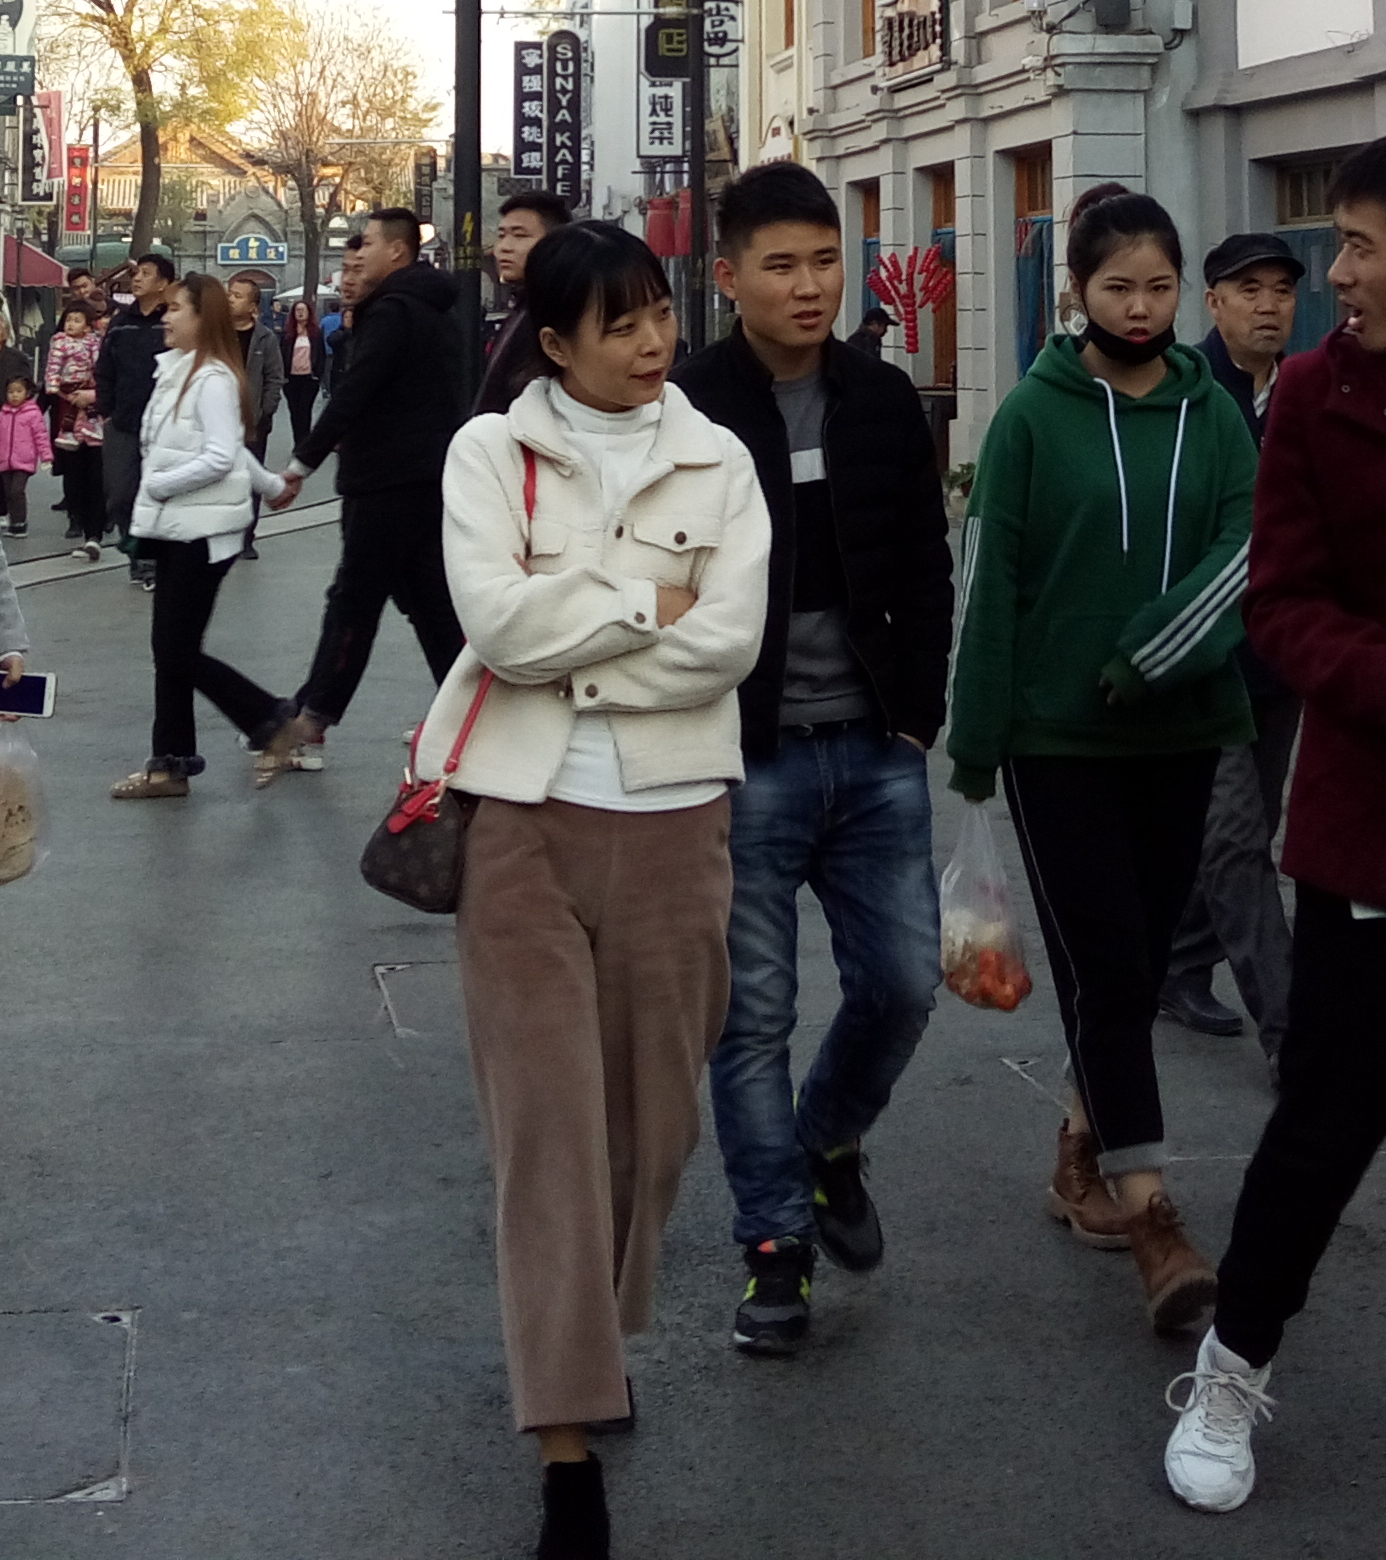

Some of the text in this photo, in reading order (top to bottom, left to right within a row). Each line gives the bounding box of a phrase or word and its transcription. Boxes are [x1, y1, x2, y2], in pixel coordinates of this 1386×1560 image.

[554, 43, 575, 196] SUNYA KAFE
[648, 81, 674, 146] 炖菜
